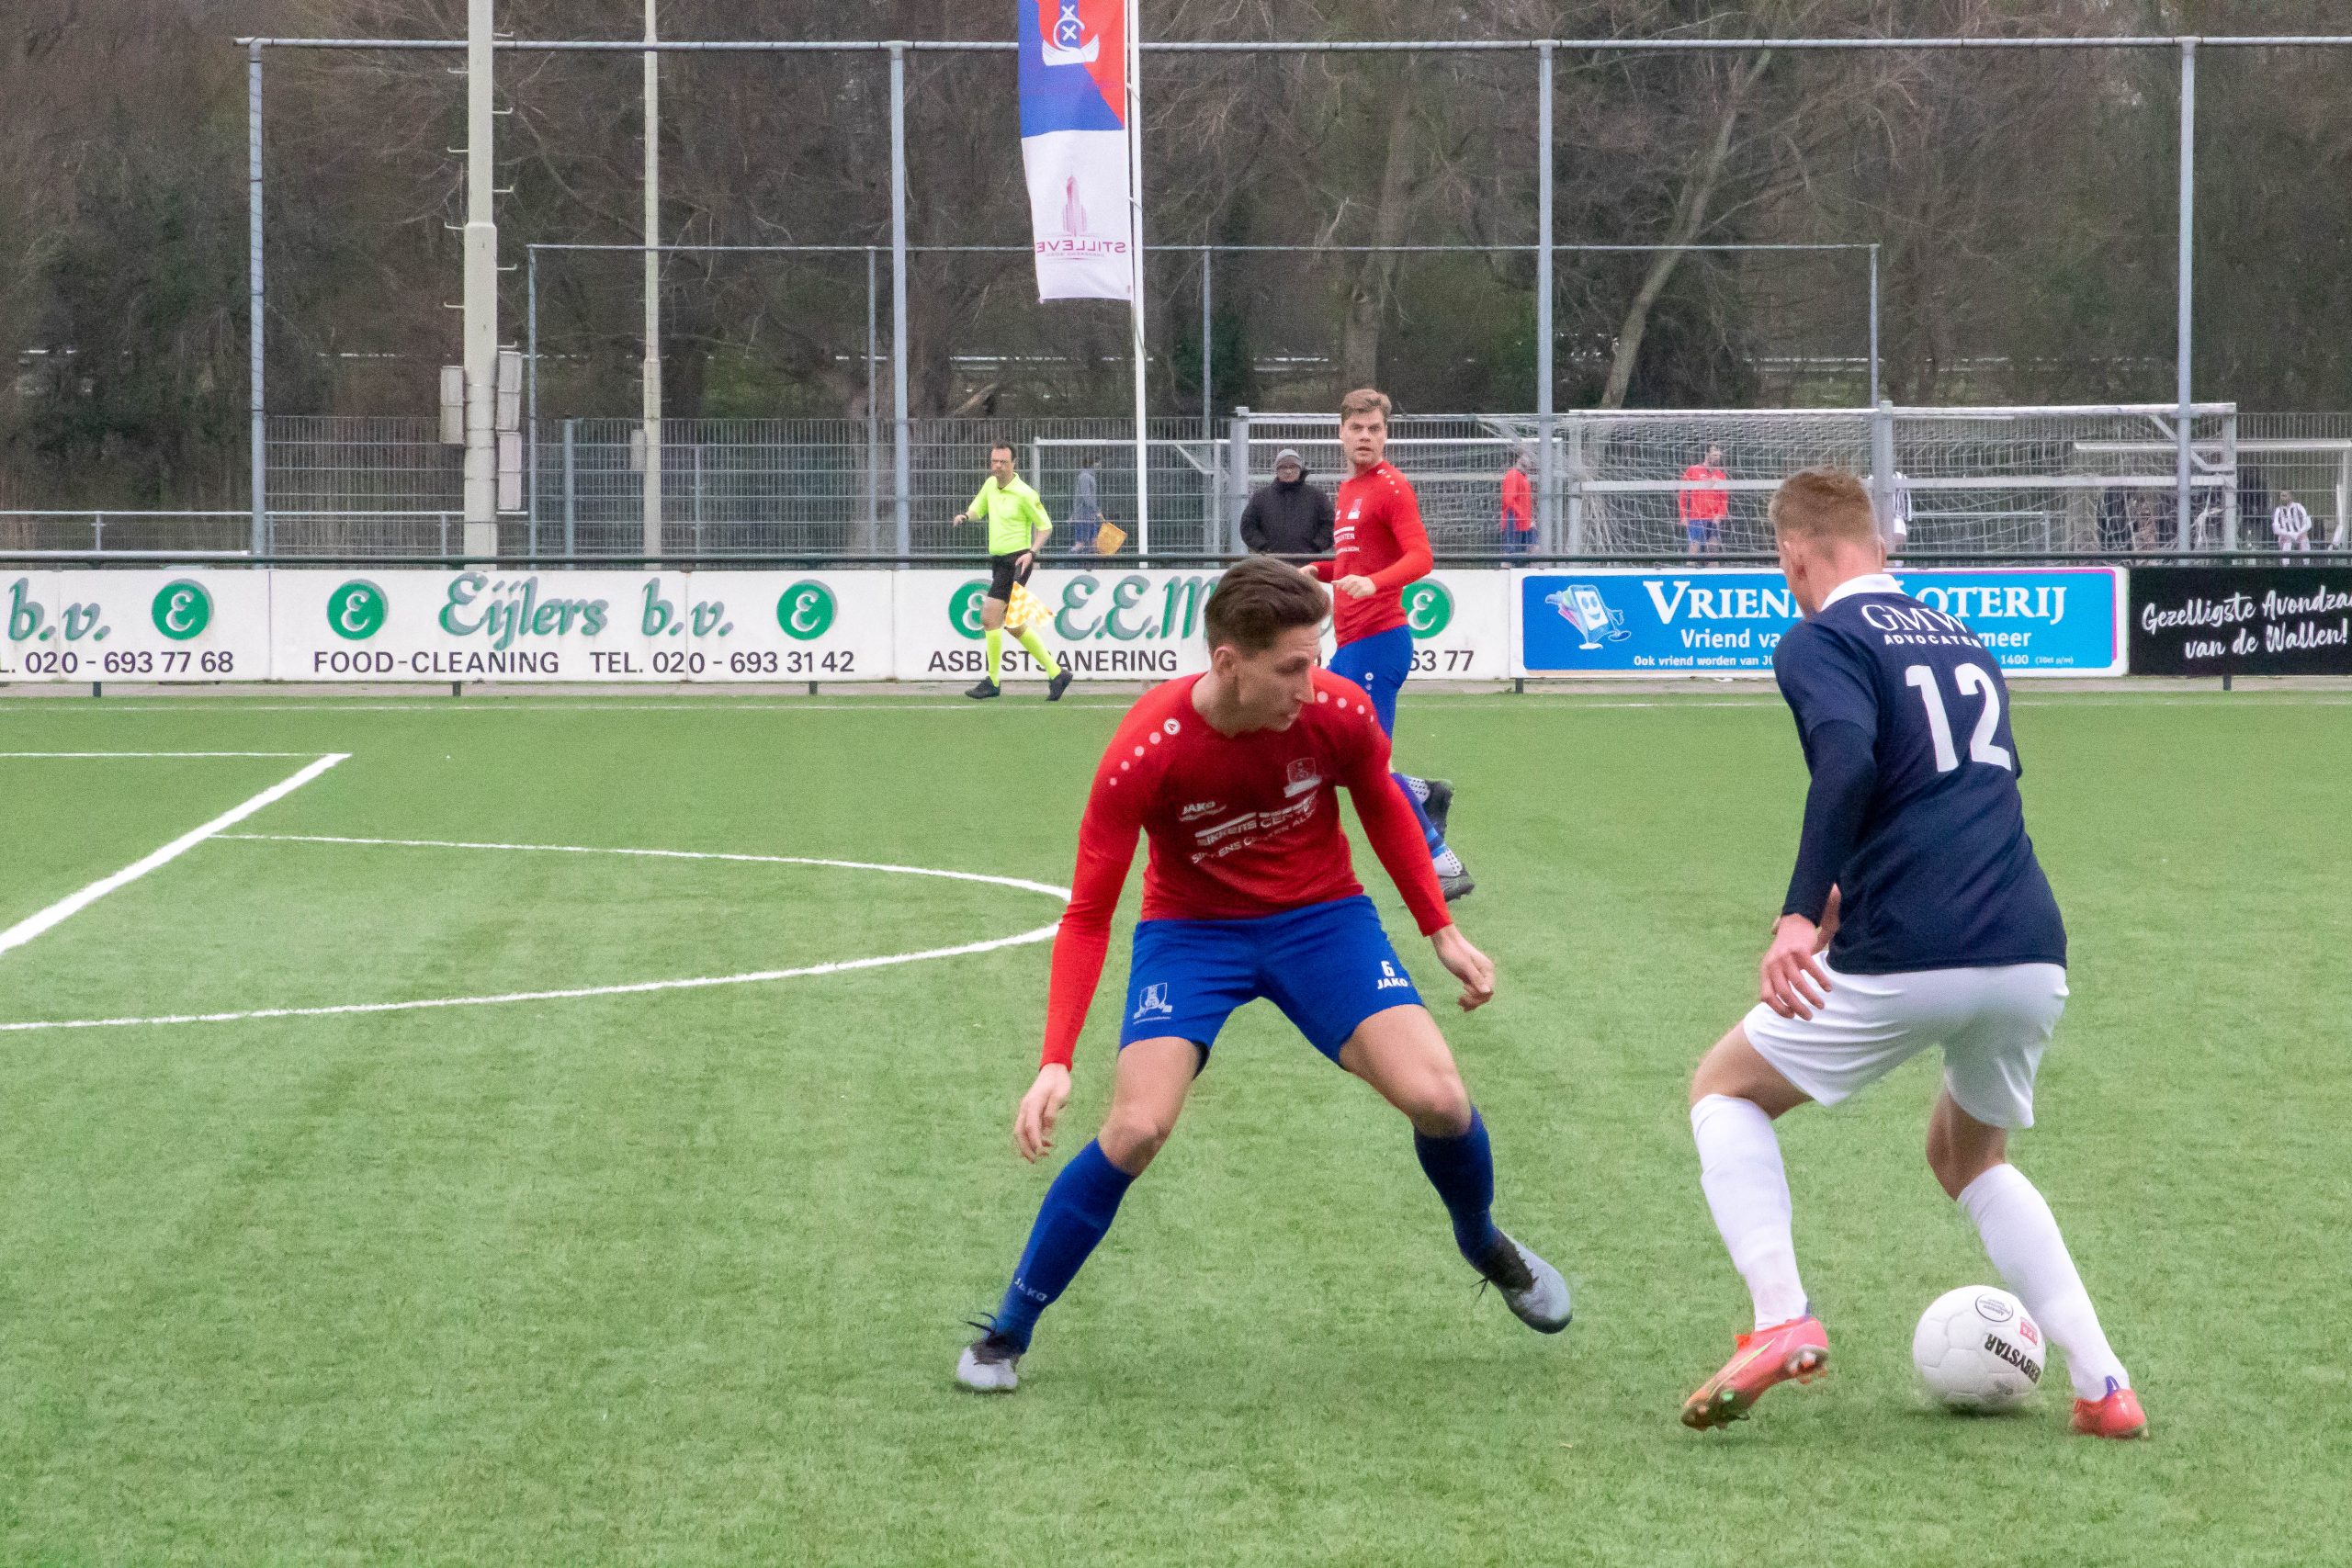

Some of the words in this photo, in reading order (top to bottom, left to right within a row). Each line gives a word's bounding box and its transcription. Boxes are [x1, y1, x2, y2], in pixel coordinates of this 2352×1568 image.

[1896, 580, 2067, 626] OTERIJ
[2143, 592, 2256, 635] Gezelligste
[2262, 585, 2352, 620] Avondza
[1861, 604, 1968, 634] GMW
[1681, 628, 1750, 648] Vriend
[1758, 633, 1781, 649] va
[1977, 632, 2032, 647] meer
[2186, 639, 2225, 659] van
[2233, 628, 2258, 655] de
[2267, 618, 2347, 652] Wallen!
[25, 651, 78, 673] 020
[104, 651, 153, 673] 693
[161, 651, 192, 672] 77
[200, 651, 233, 673] 68
[313, 650, 560, 673] FOOD-CLEANING
[589, 651, 643, 673] TEL.
[652, 651, 705, 673] 020
[730, 651, 778, 673] 693
[928, 650, 1177, 672] ASBSTANERING
[1444, 650, 1475, 671] 77
[1634, 656, 1655, 666] Ook
[1658, 655, 1693, 666] vriend
[1697, 655, 1736, 666] worden
[1740, 657, 1759, 666] van
[1905, 663, 2011, 772] 12
[1182, 801, 1216, 815] JAKO
[1381, 960, 1396, 977] 6
[1377, 977, 1408, 989] JAKO
